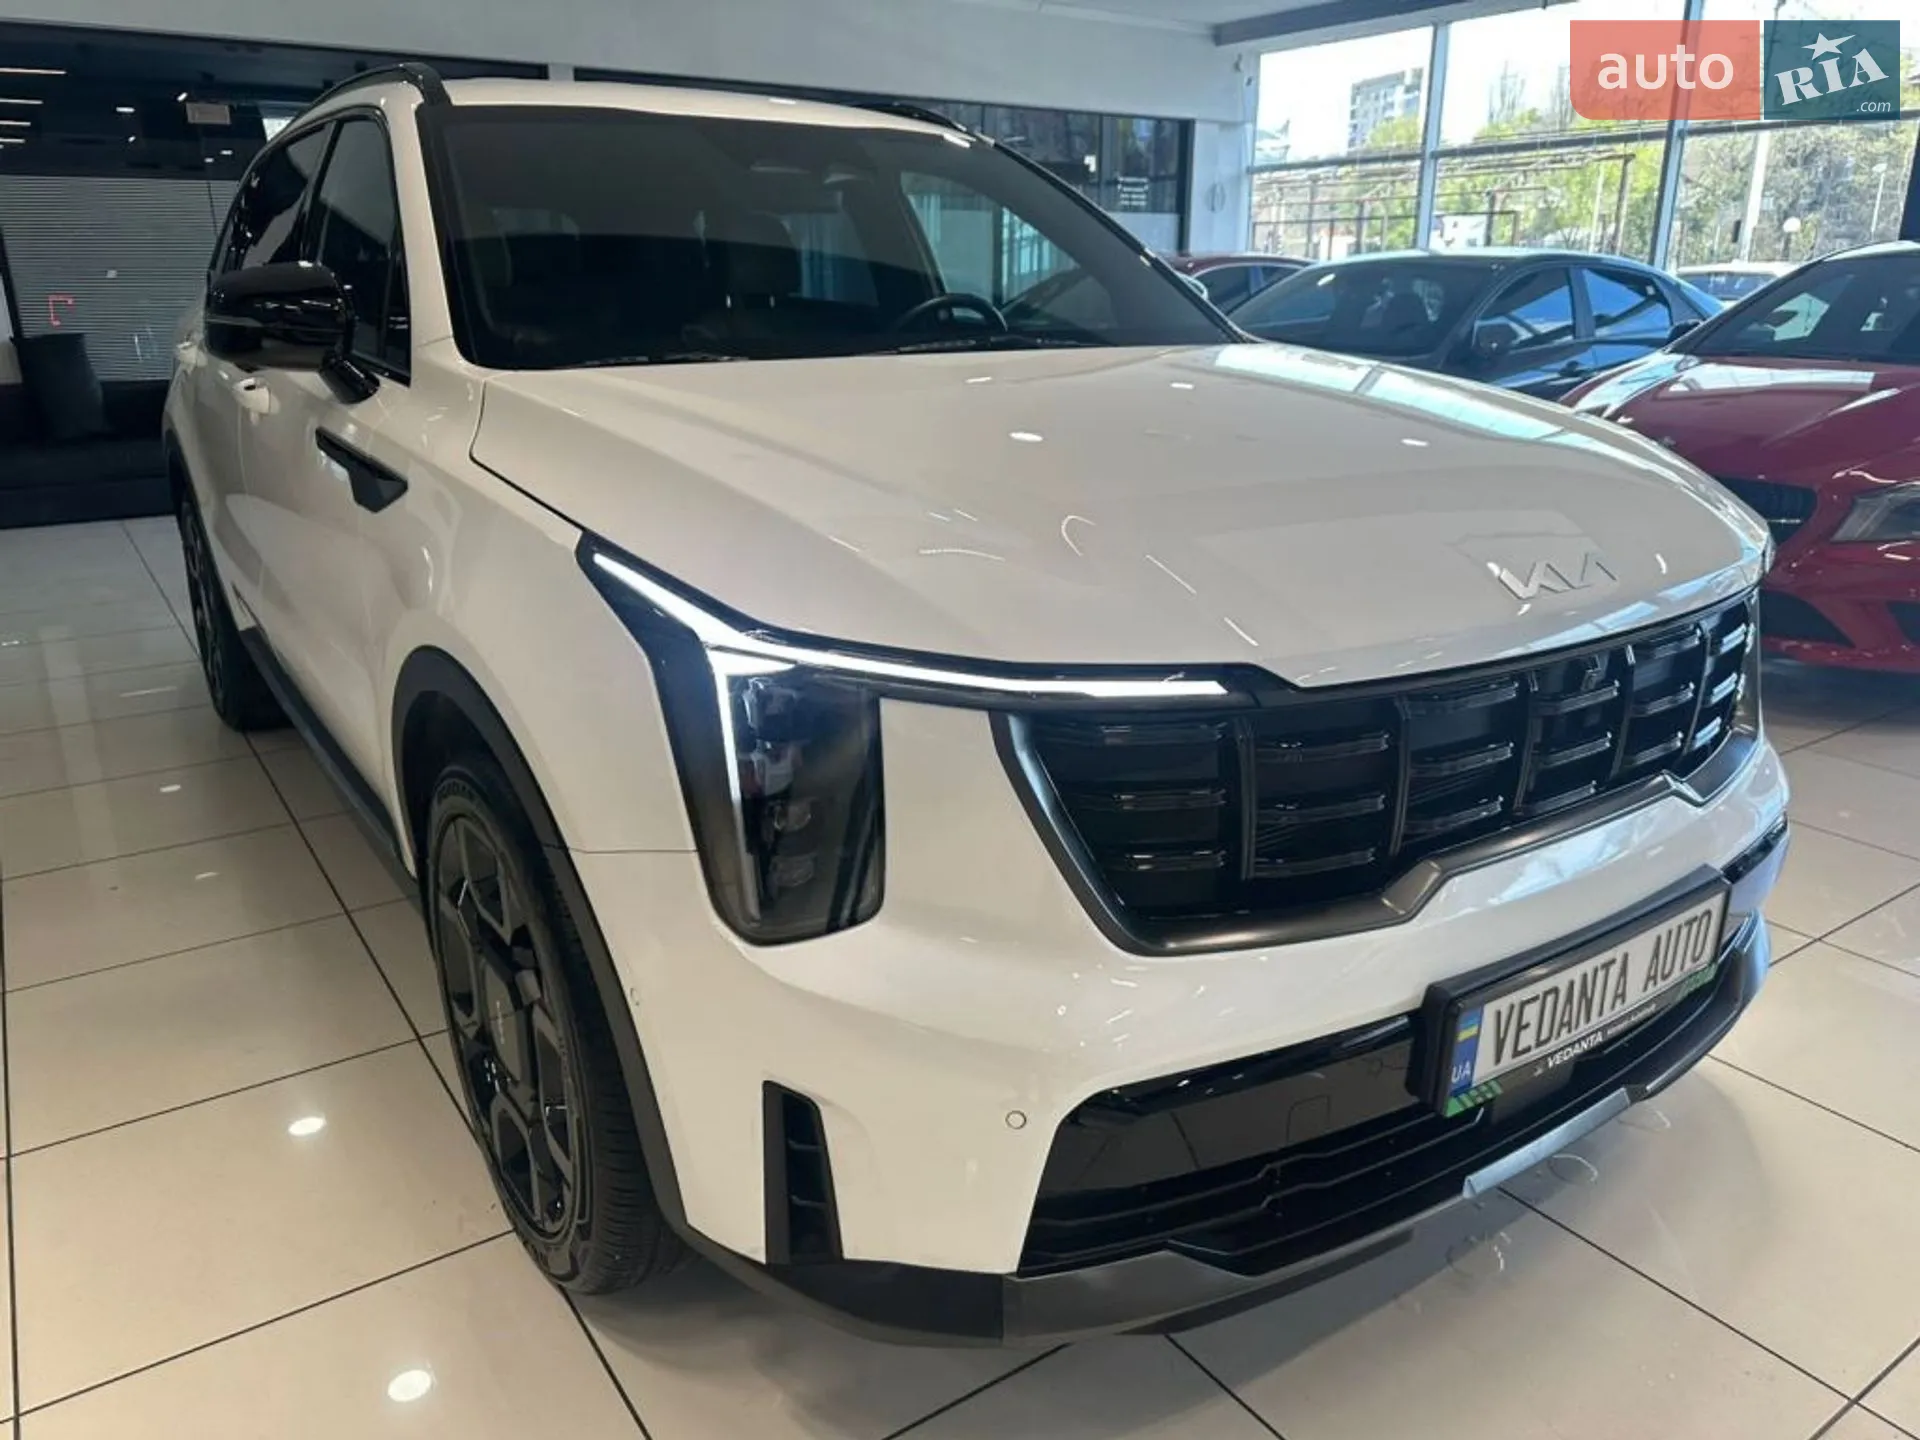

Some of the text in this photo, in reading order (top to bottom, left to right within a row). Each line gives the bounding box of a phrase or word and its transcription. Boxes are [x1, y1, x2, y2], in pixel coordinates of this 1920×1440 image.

[1493, 909, 1712, 1066] VEDANTA AUTO
[1547, 1030, 1603, 1068] VEDANTA
[1451, 1060, 1471, 1085] UA
